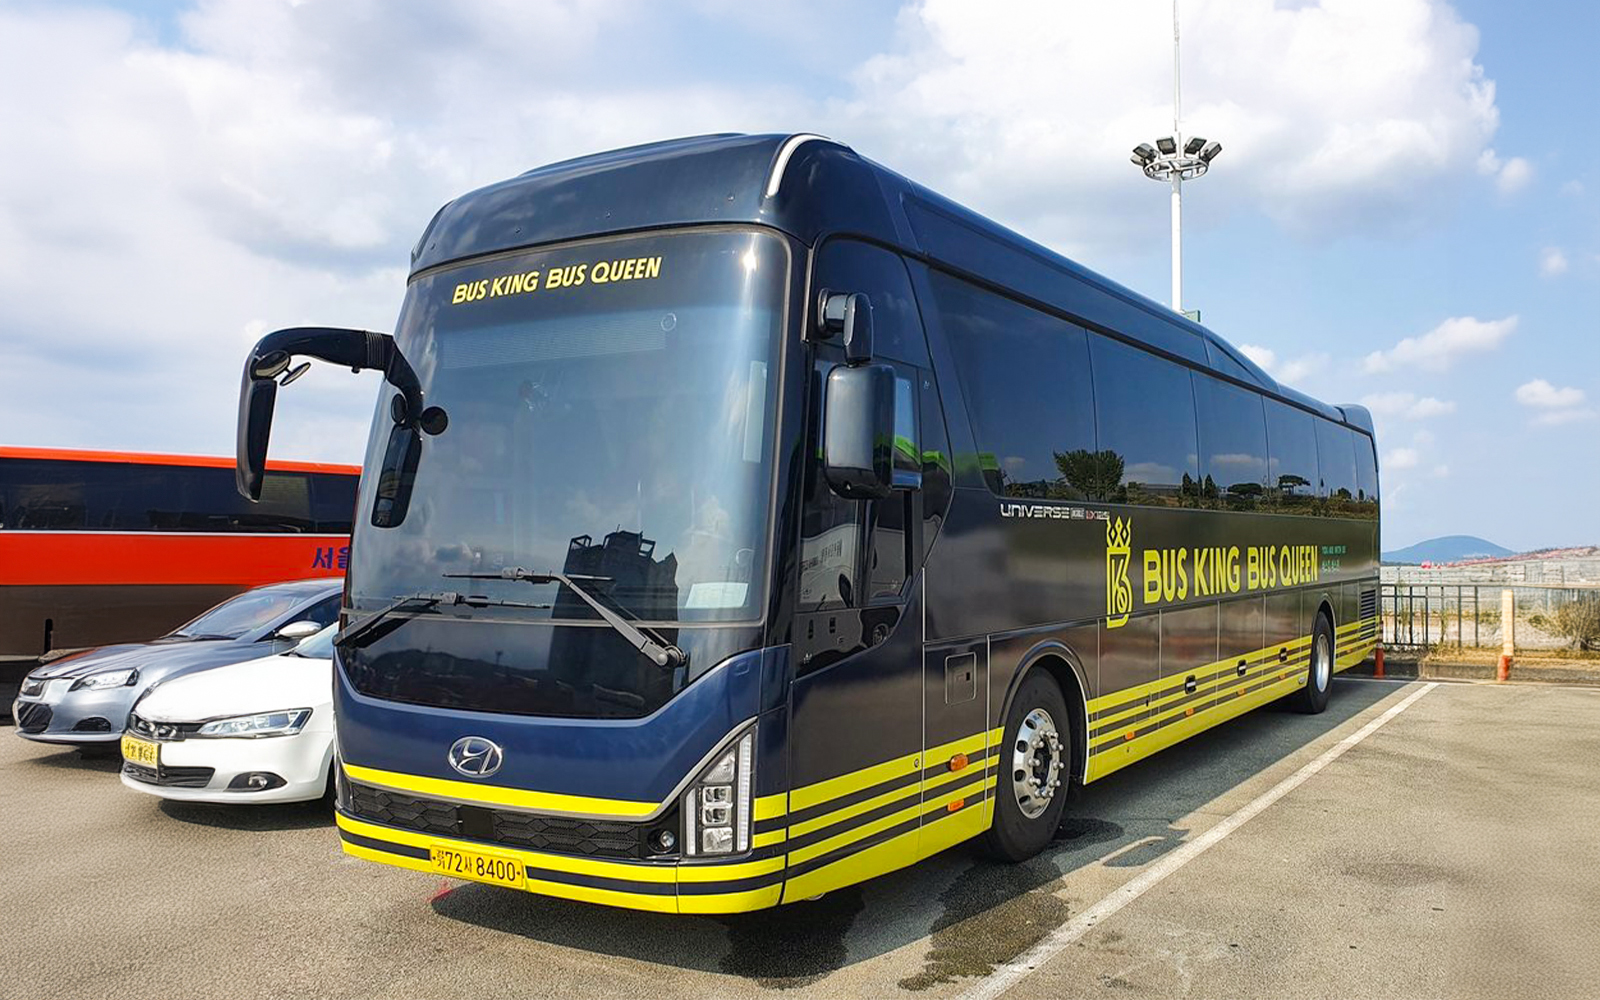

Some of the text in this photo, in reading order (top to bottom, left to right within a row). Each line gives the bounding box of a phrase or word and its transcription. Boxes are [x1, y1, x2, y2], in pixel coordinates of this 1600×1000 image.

[452, 257, 662, 304] BUS KING BUS QUEEN
[1000, 503, 1070, 519] UNIVERSE
[1143, 547, 1188, 604] BUS
[1194, 545, 1240, 597] KING
[1247, 545, 1277, 591] BUS
[1279, 544, 1318, 586] QUEEN
[476, 857, 516, 882] 8400
